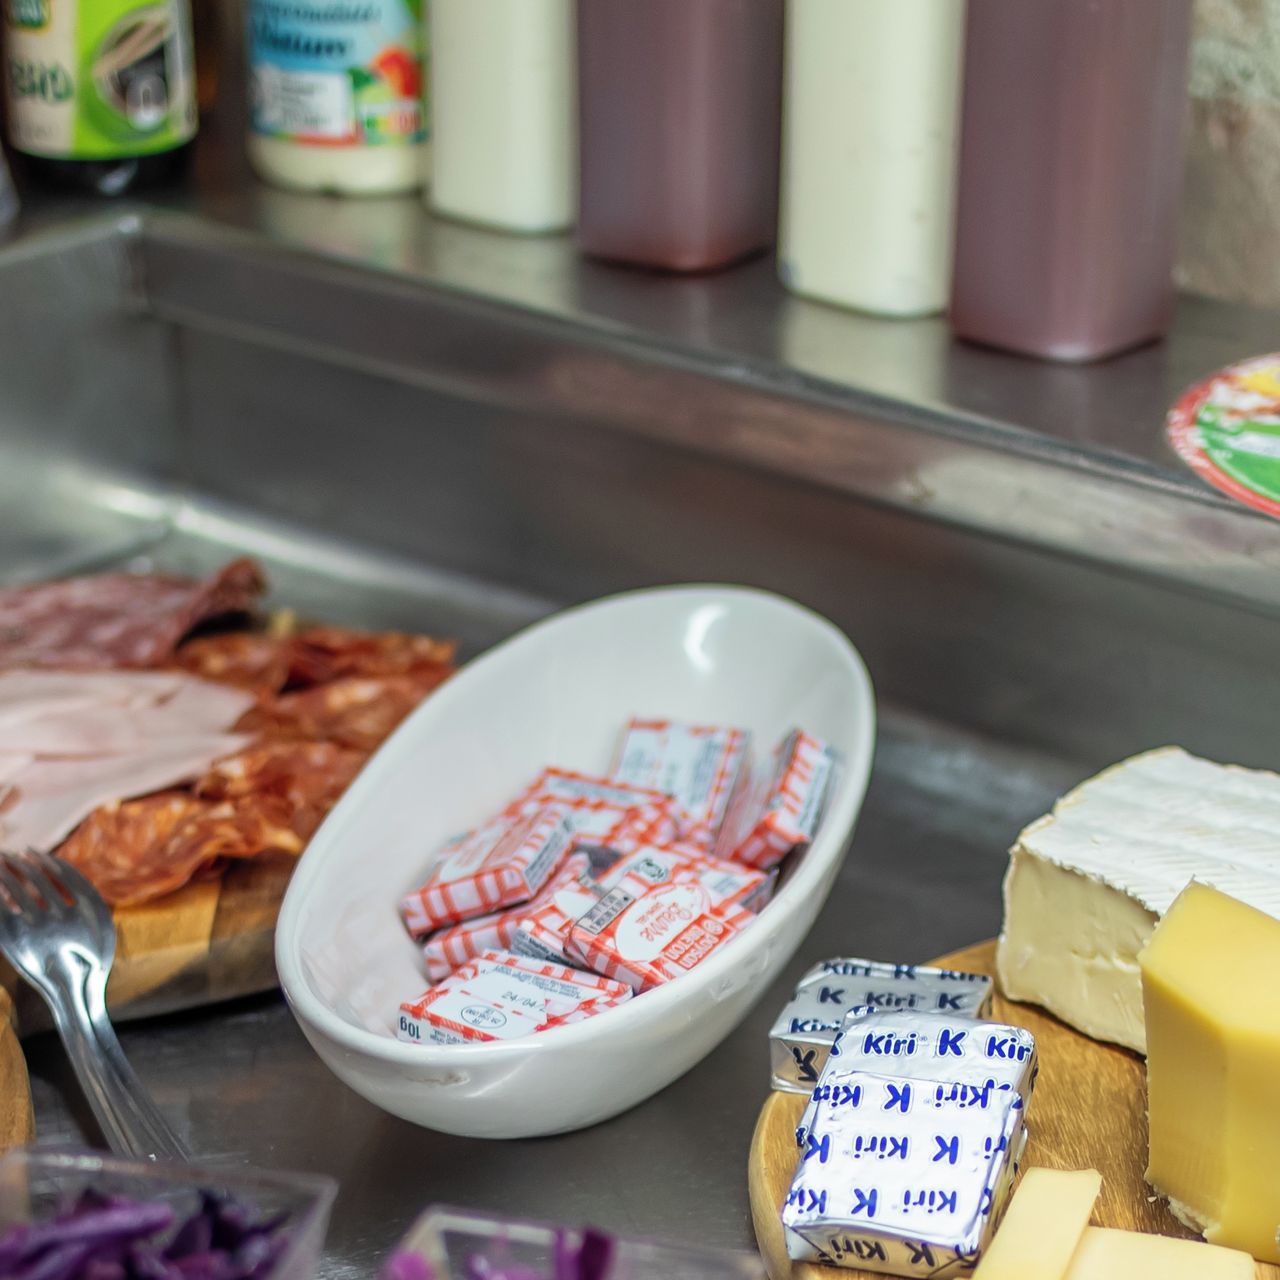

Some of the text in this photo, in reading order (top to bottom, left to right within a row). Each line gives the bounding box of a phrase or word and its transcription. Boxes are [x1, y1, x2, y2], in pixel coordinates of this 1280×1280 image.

[820, 987, 963, 1010] K Kiri K
[399, 1015, 421, 1041] 10g
[863, 1029, 1032, 1061] Kiri K Kir
[883, 1083, 911, 1113] K
[934, 1084, 989, 1109] Kiri
[803, 1134, 830, 1163] K
[854, 1136, 909, 1160] Kiri
[932, 1135, 959, 1165] K
[850, 1188, 878, 1218] K
[903, 1190, 957, 1214] Kiri
[830, 1238, 935, 1267] K Kiri
